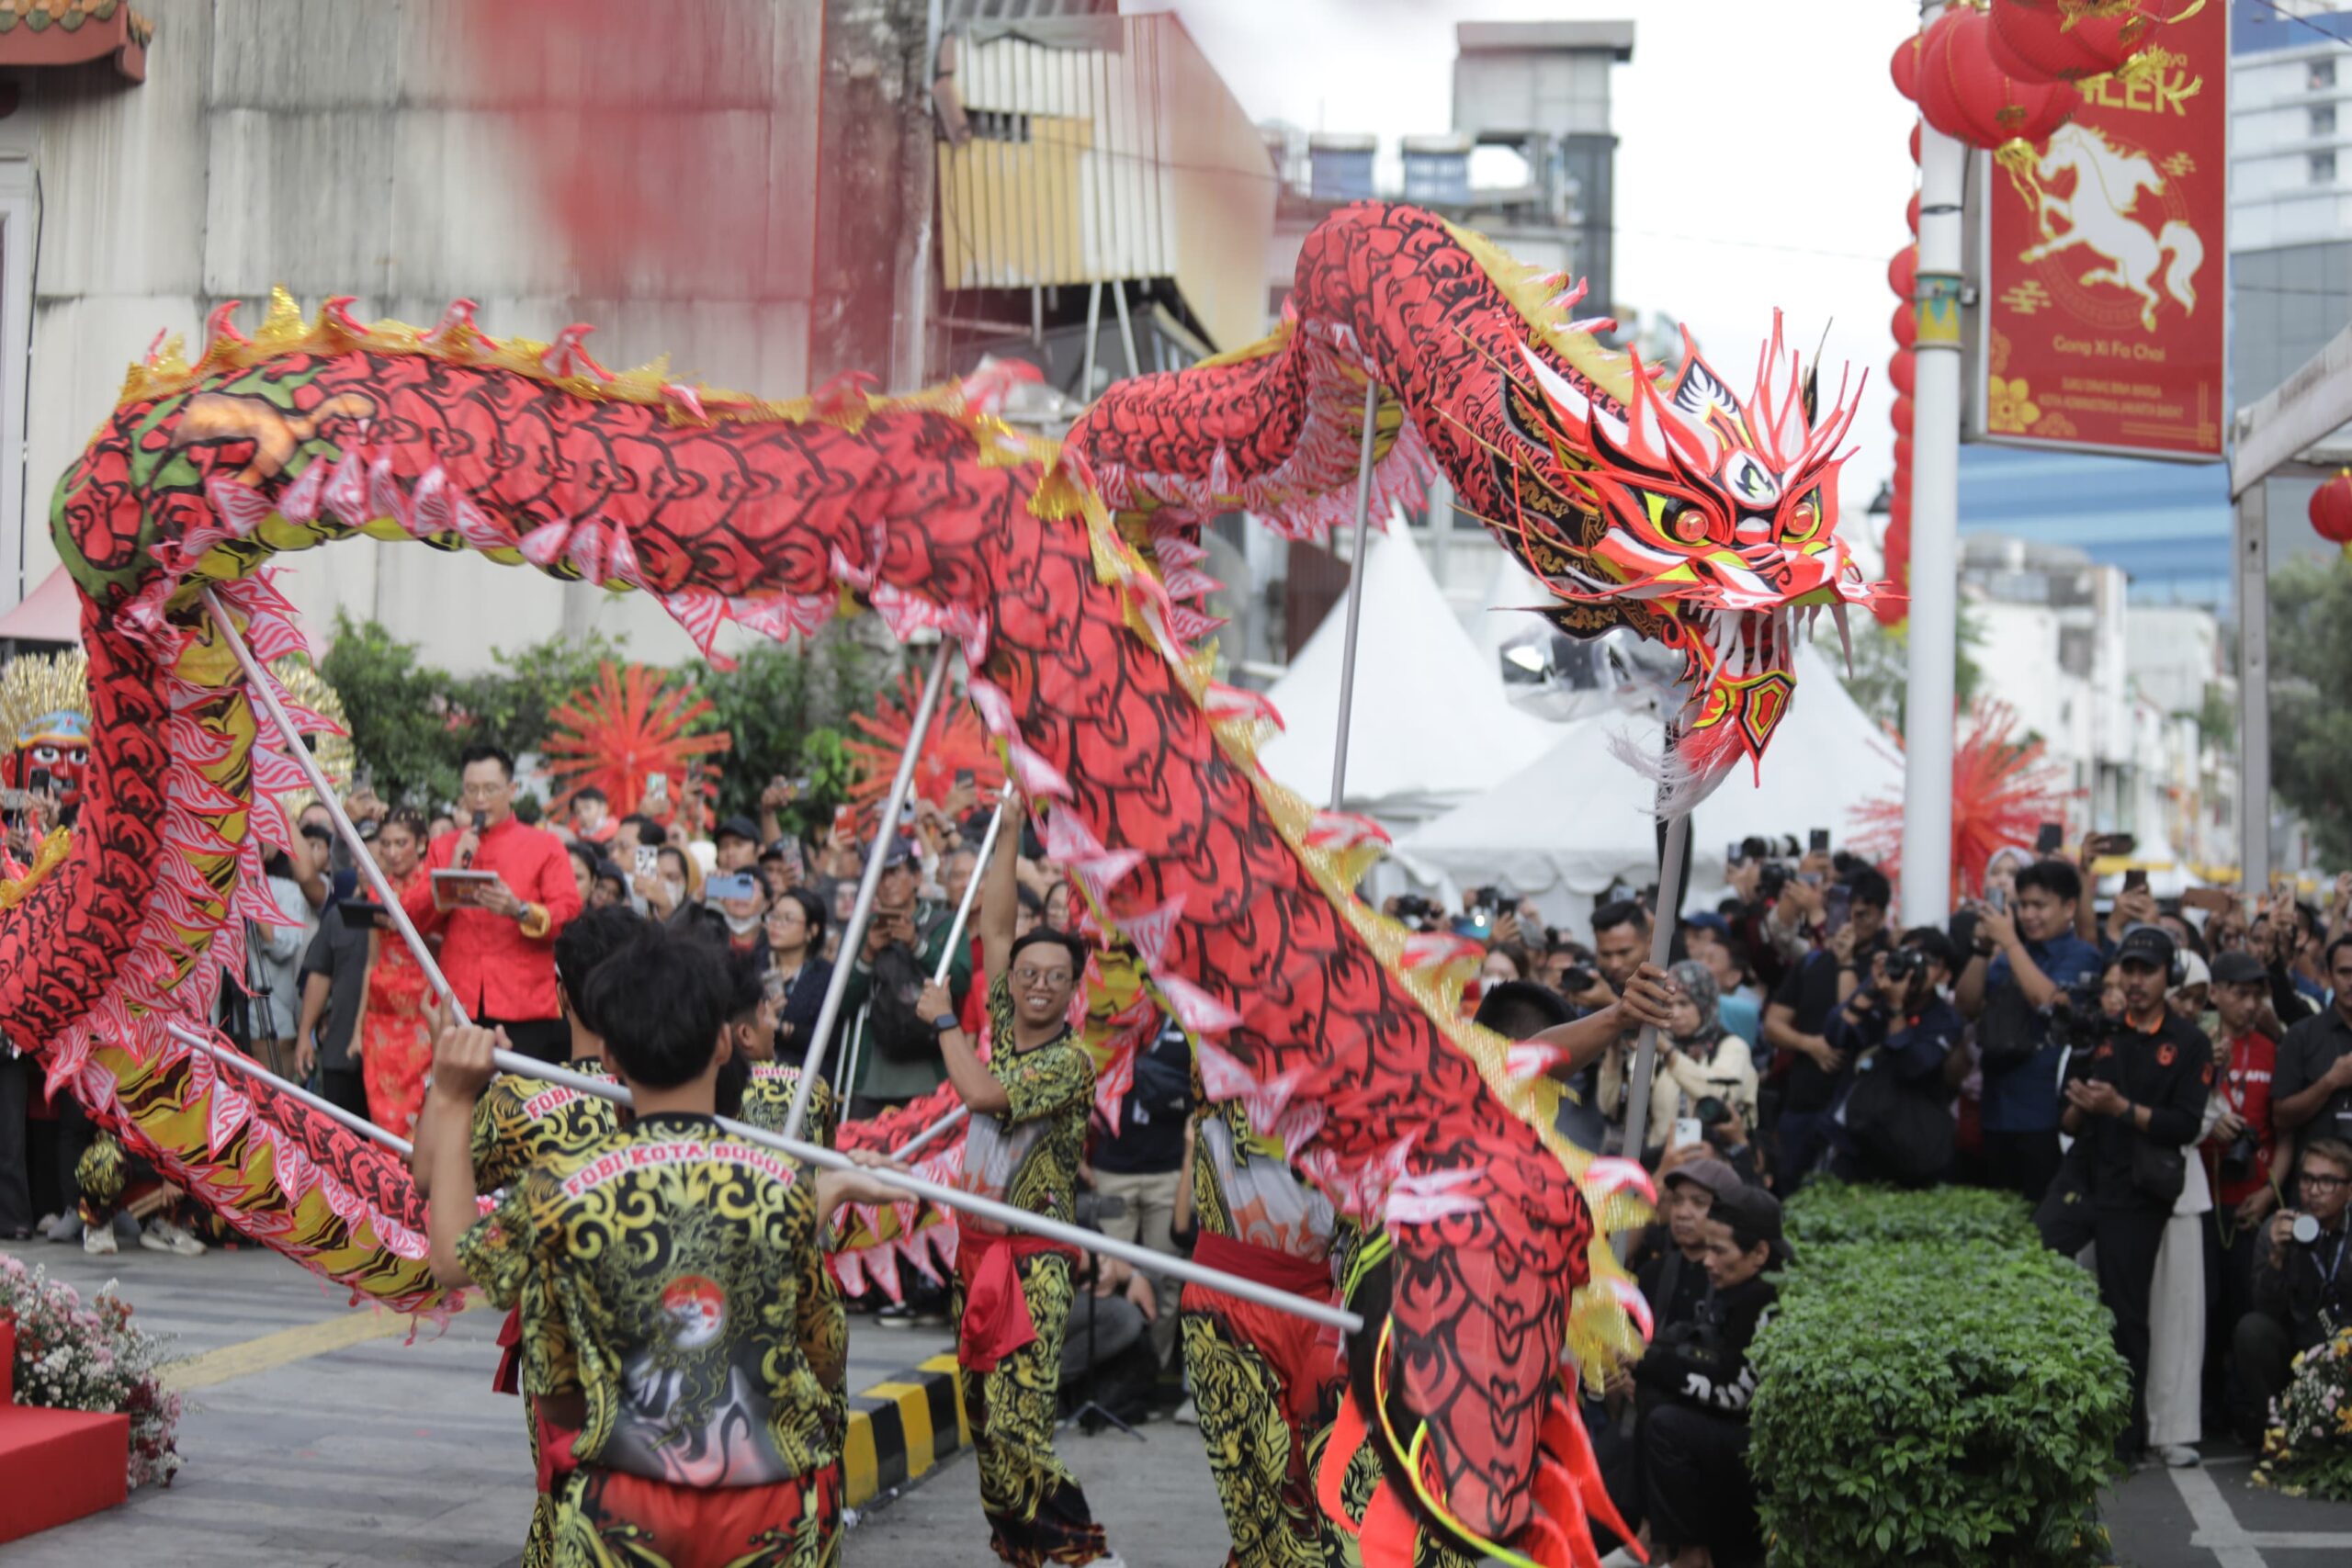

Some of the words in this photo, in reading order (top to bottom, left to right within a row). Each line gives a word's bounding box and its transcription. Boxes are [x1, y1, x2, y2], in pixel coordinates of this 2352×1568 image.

[525, 1087, 574, 1122] FOBI
[563, 1154, 624, 1196] FOBI
[629, 1144, 704, 1165] KOTA
[714, 1145, 795, 1187] BOGOR
